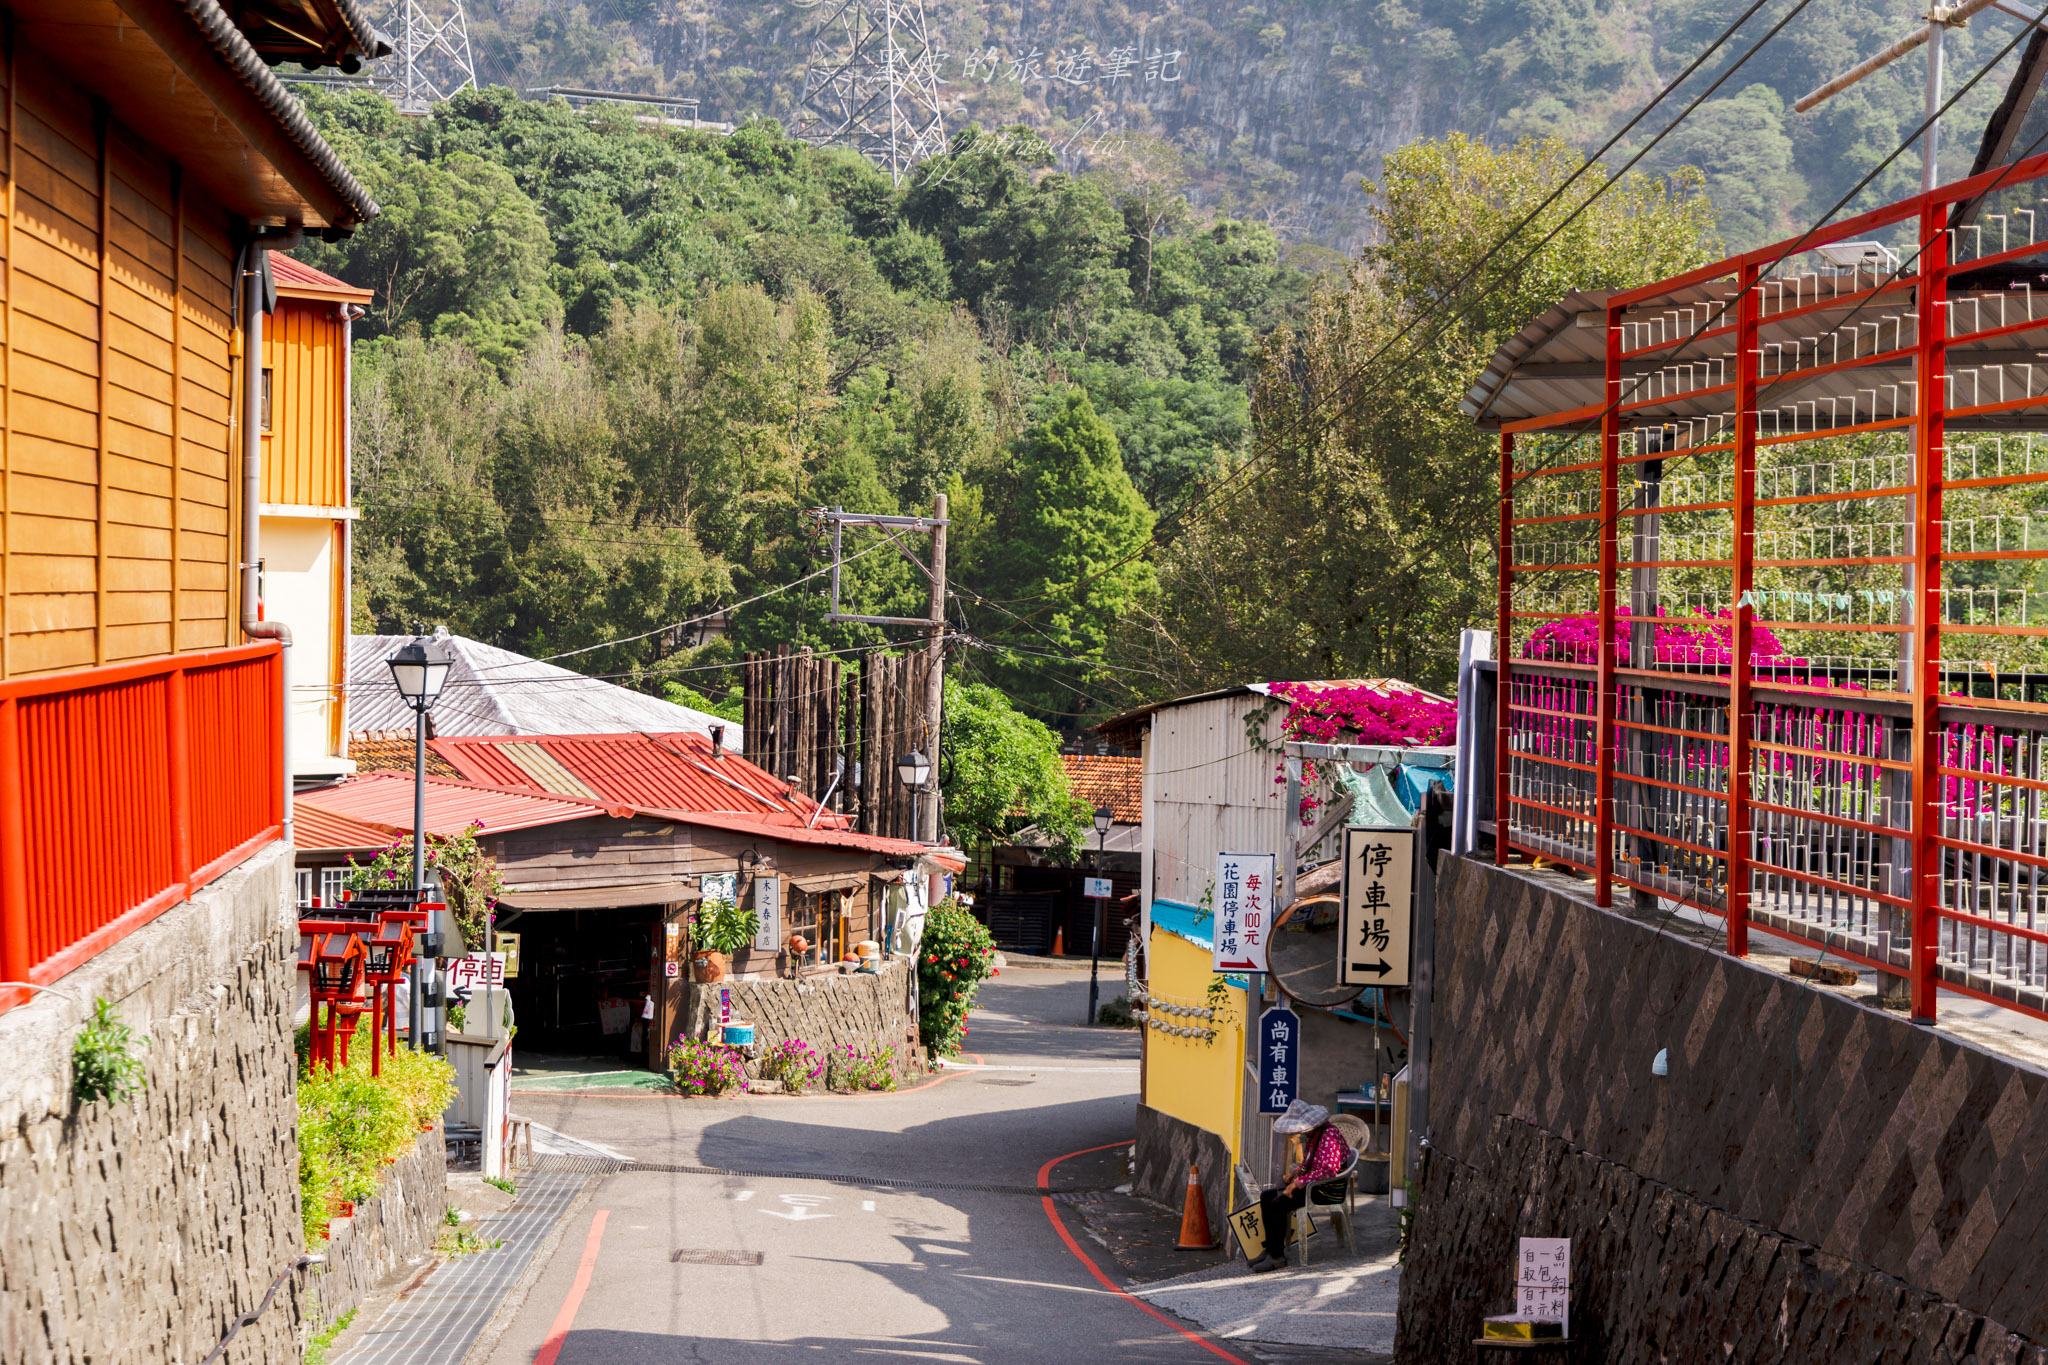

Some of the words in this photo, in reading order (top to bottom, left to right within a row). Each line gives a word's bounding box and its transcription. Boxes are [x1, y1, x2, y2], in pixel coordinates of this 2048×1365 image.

[1220, 862, 1240, 957] 花園停車場
[1244, 873, 1263, 946] 每次100元
[1358, 843, 1393, 953] 停車場
[1269, 1020, 1290, 1109] 尚有車位
